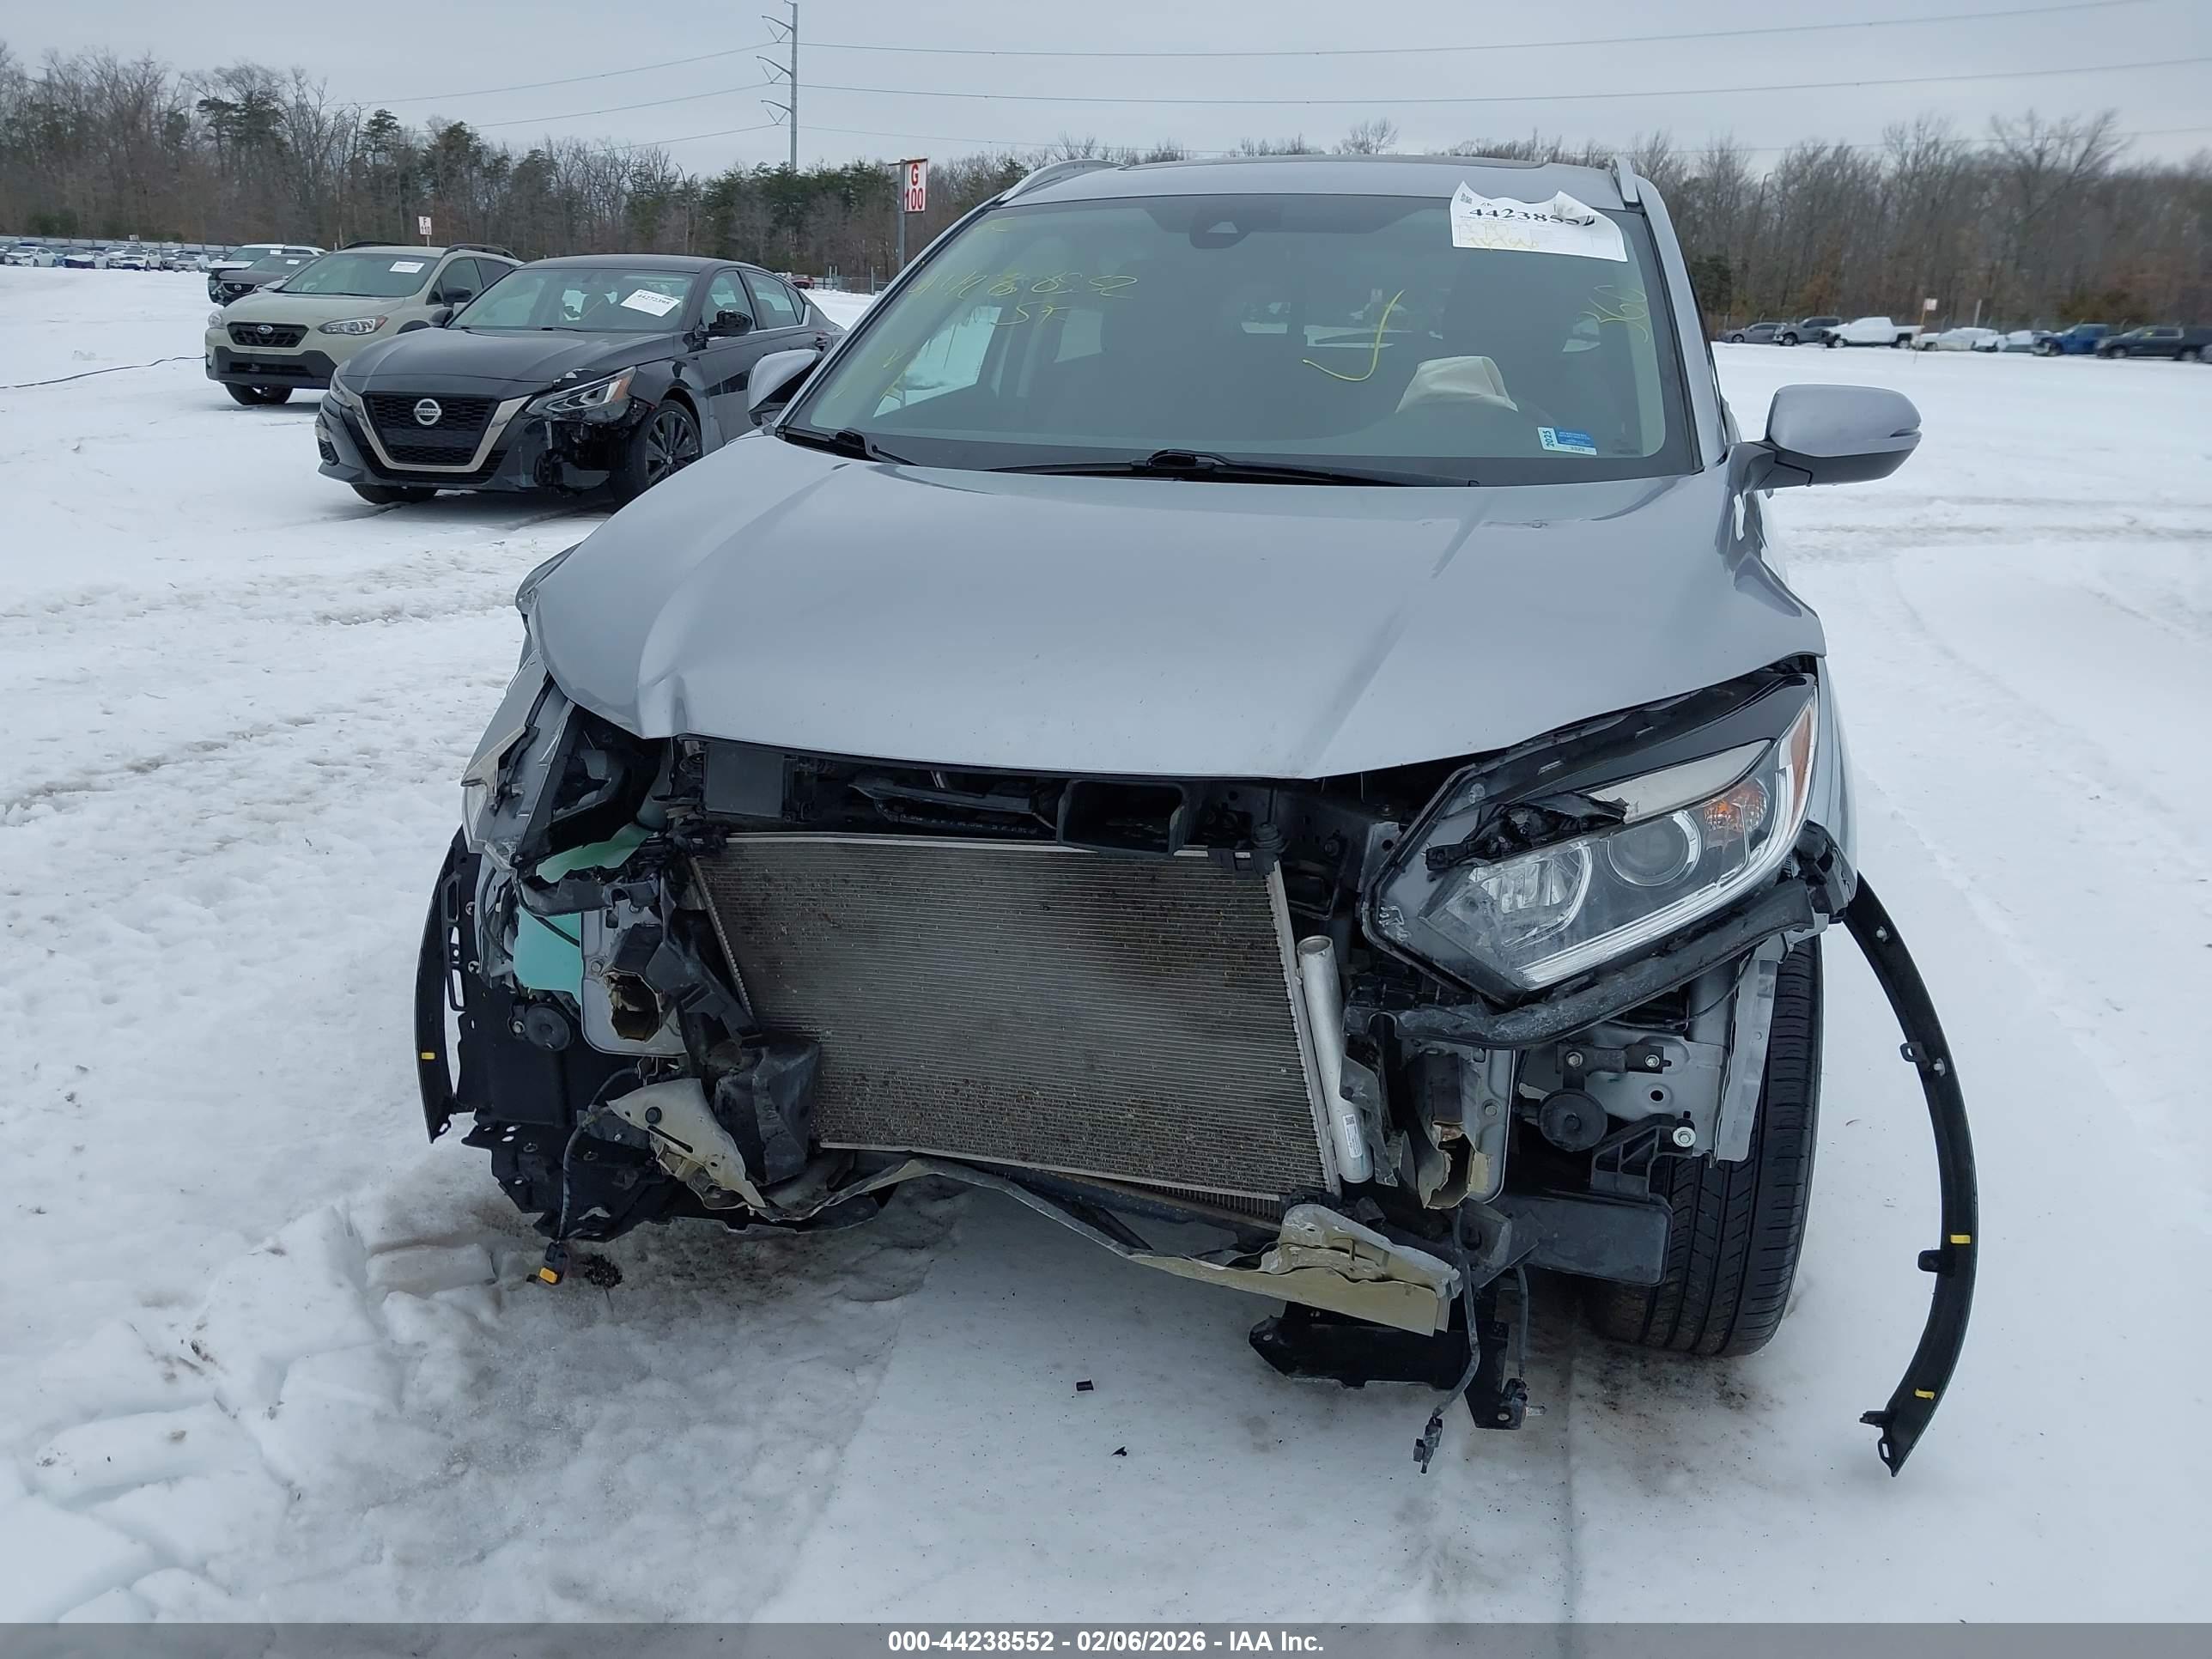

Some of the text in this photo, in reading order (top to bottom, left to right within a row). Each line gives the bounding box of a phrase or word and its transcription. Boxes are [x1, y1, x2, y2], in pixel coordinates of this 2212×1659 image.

[911, 163, 919, 186] G
[905, 188, 924, 210] 100
[1542, 430, 1555, 447] 2025
